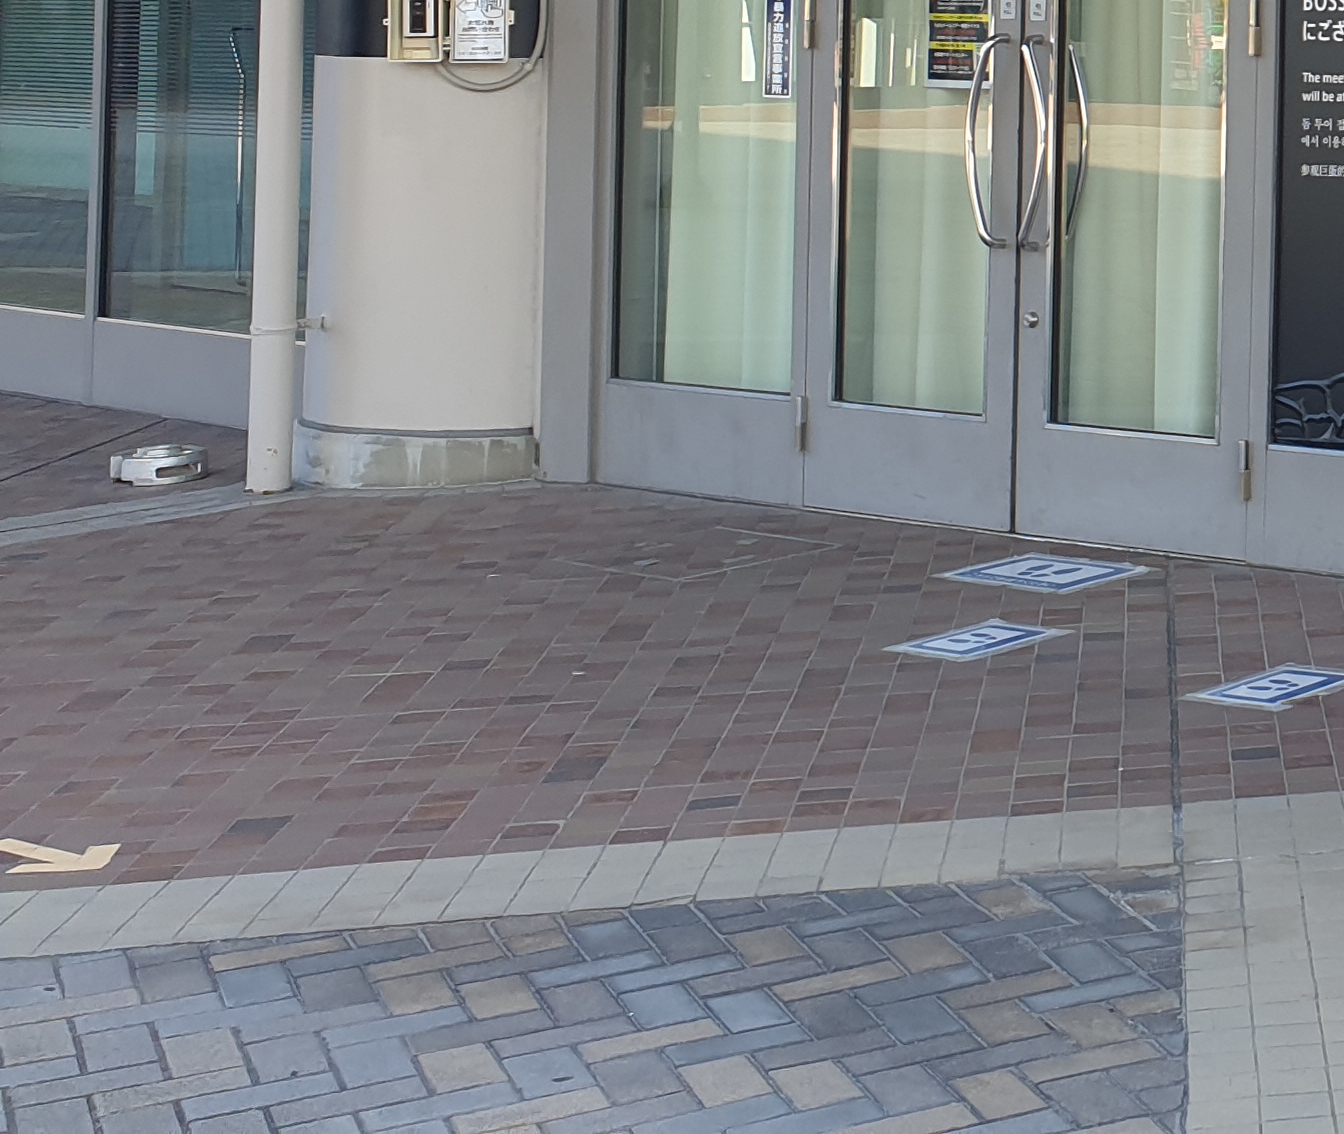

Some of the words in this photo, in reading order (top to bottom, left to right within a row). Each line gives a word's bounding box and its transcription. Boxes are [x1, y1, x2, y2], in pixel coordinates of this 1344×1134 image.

[1302, 72, 1320, 83] The
[1302, 91, 1320, 101] will
[1322, 91, 1334, 102] be
